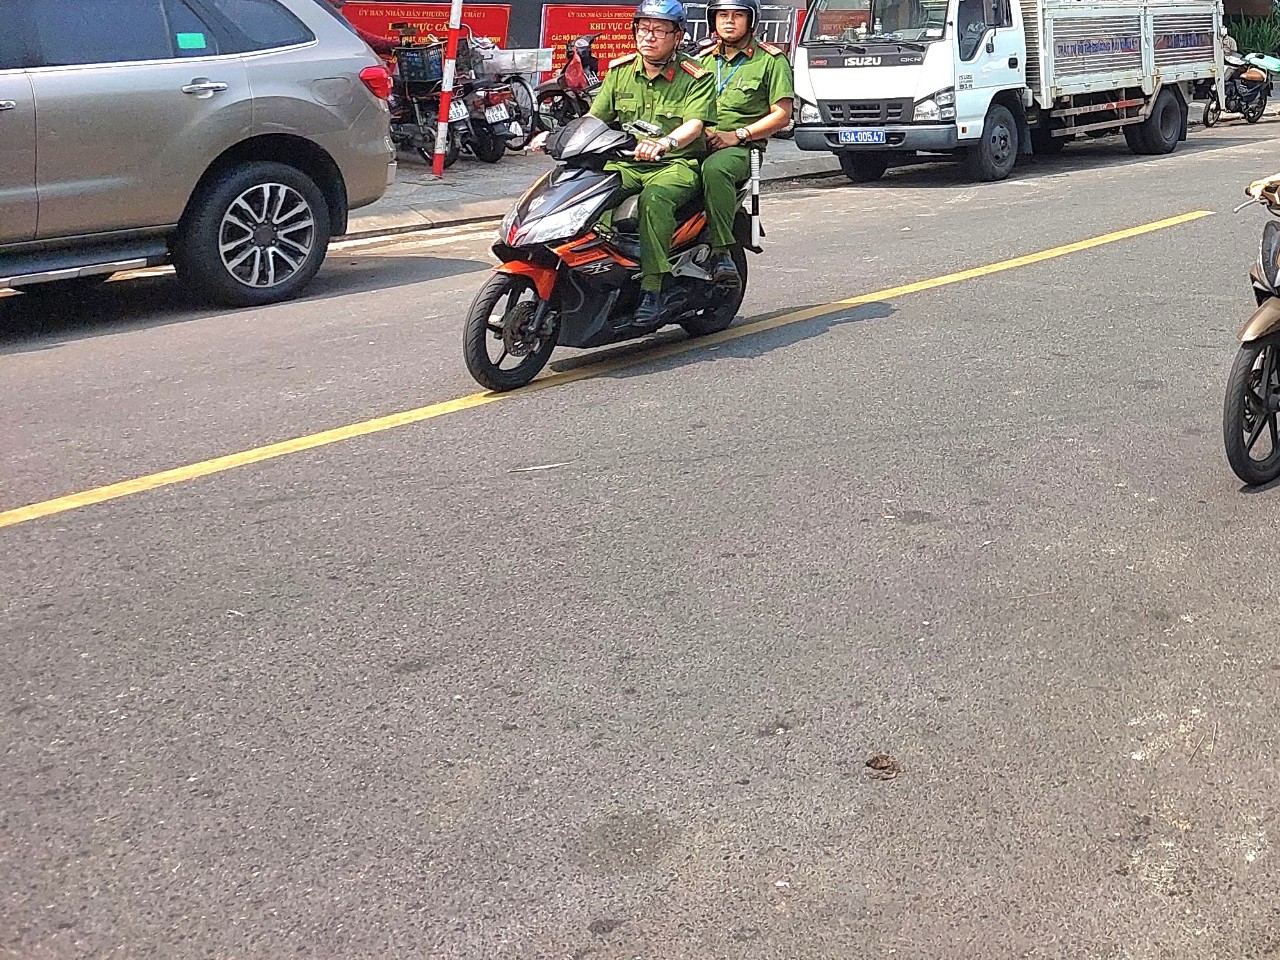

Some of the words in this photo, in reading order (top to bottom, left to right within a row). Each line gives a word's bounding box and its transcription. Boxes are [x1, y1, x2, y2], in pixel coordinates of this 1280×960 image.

[590, 22, 606, 30] KHU
[608, 22, 622, 31] VỰC
[844, 56, 882, 67] ISUZU
